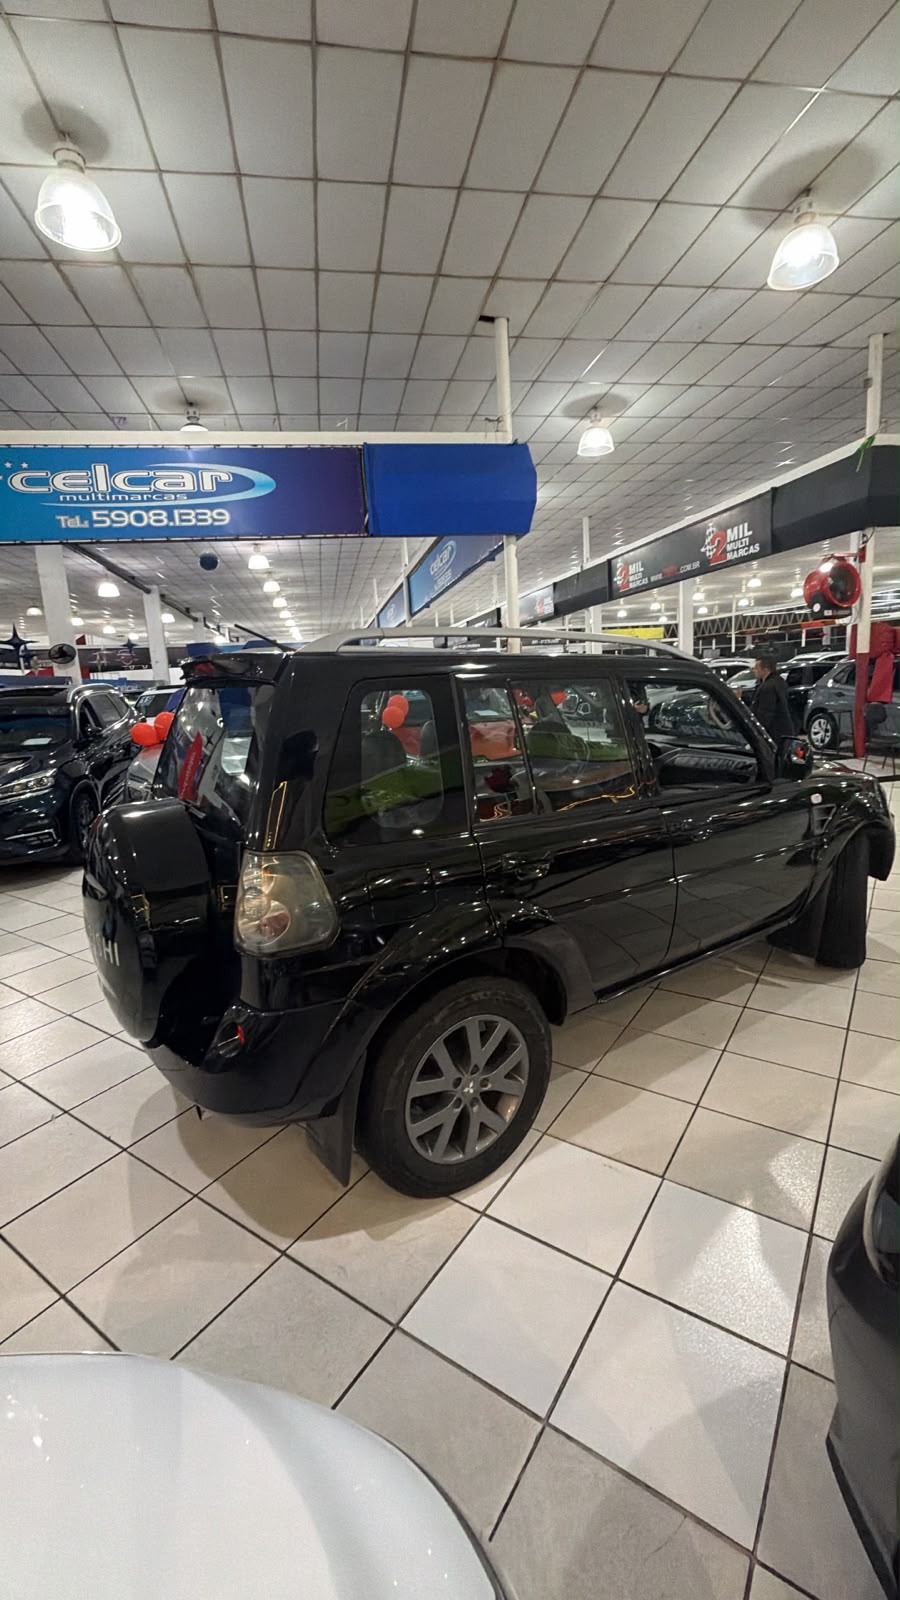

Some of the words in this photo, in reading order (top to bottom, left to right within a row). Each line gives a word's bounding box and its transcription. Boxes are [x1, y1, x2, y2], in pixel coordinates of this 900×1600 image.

[9, 464, 232, 493] celcar
[59, 492, 188, 501] multimarcas
[726, 522, 753, 544] MIL
[726, 537, 749, 552] MULTI
[726, 543, 760, 561] MARCAS
[629, 560, 645, 576] MIL
